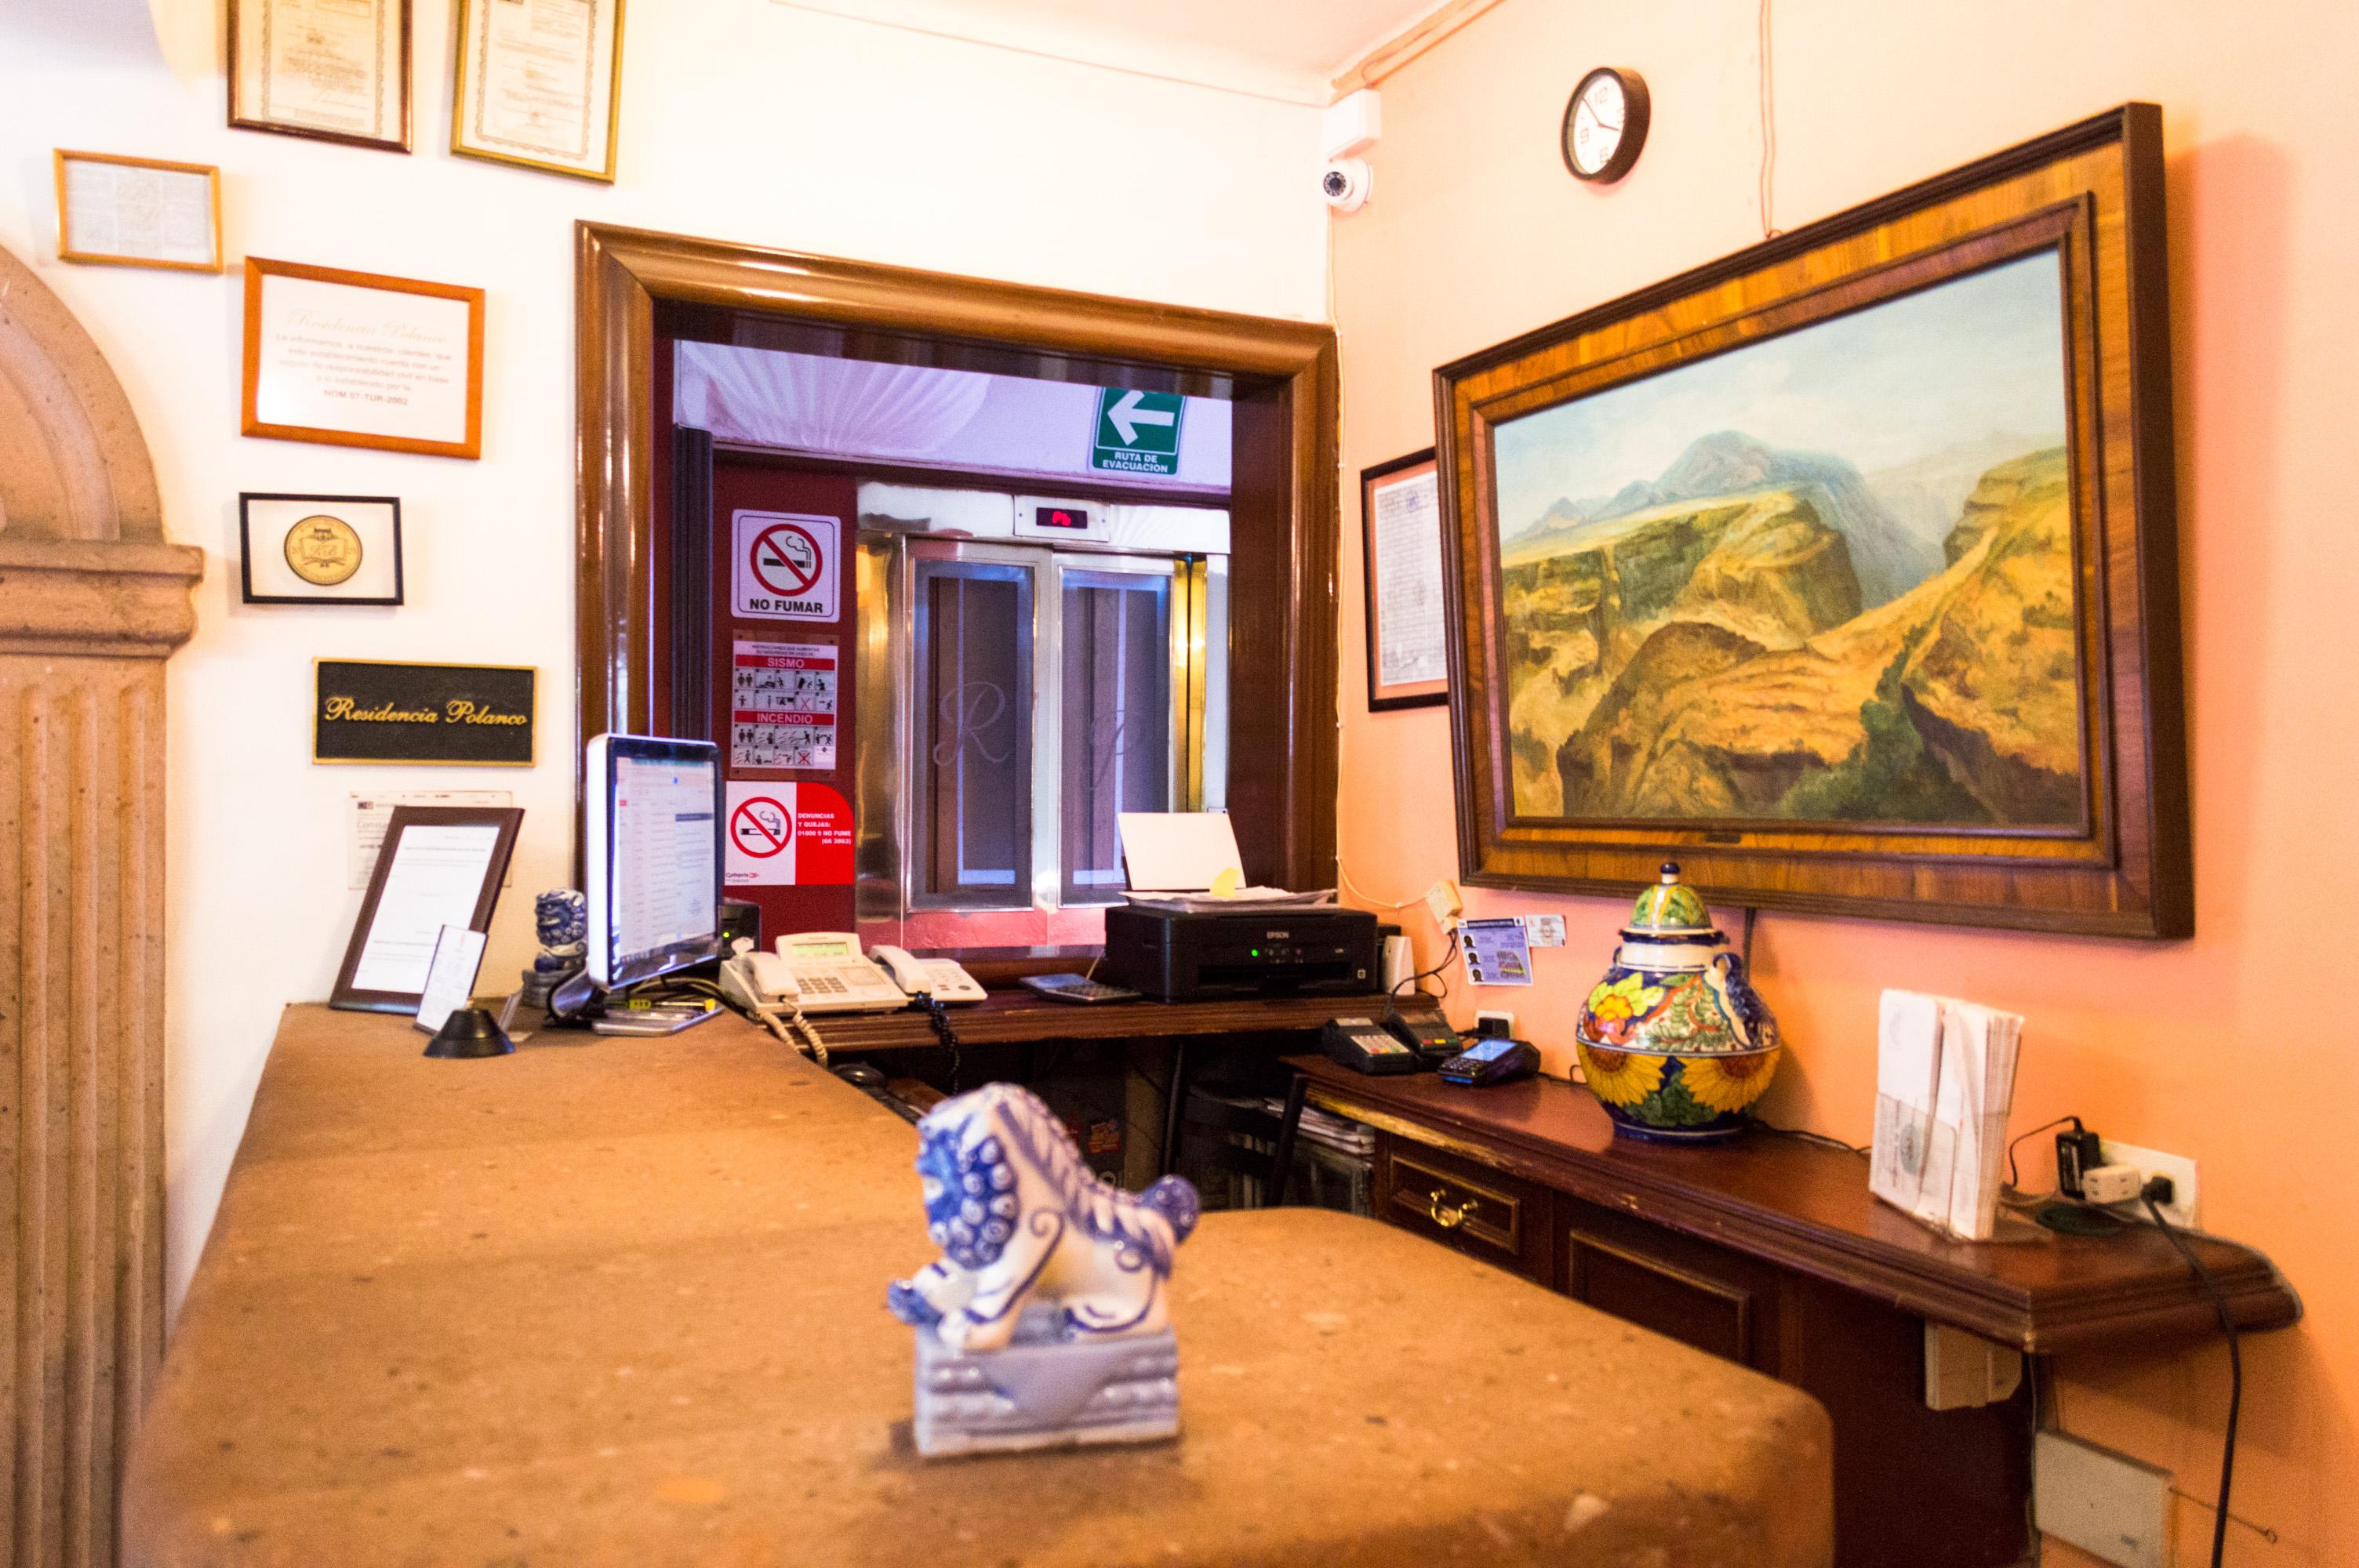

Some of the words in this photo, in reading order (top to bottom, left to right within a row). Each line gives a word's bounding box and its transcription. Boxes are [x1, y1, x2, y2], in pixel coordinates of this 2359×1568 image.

[323, 389, 347, 398] NOM
[1114, 452, 1142, 463] RUTA
[1143, 454, 1158, 464] DE
[1102, 459, 1168, 474] EVACUACION
[750, 598, 770, 611] NO
[775, 600, 823, 613] FUMAR
[767, 657, 805, 669] SISMO
[325, 695, 439, 724] Residencia
[445, 699, 528, 728] Polanco
[757, 713, 812, 724] INCENDIO
